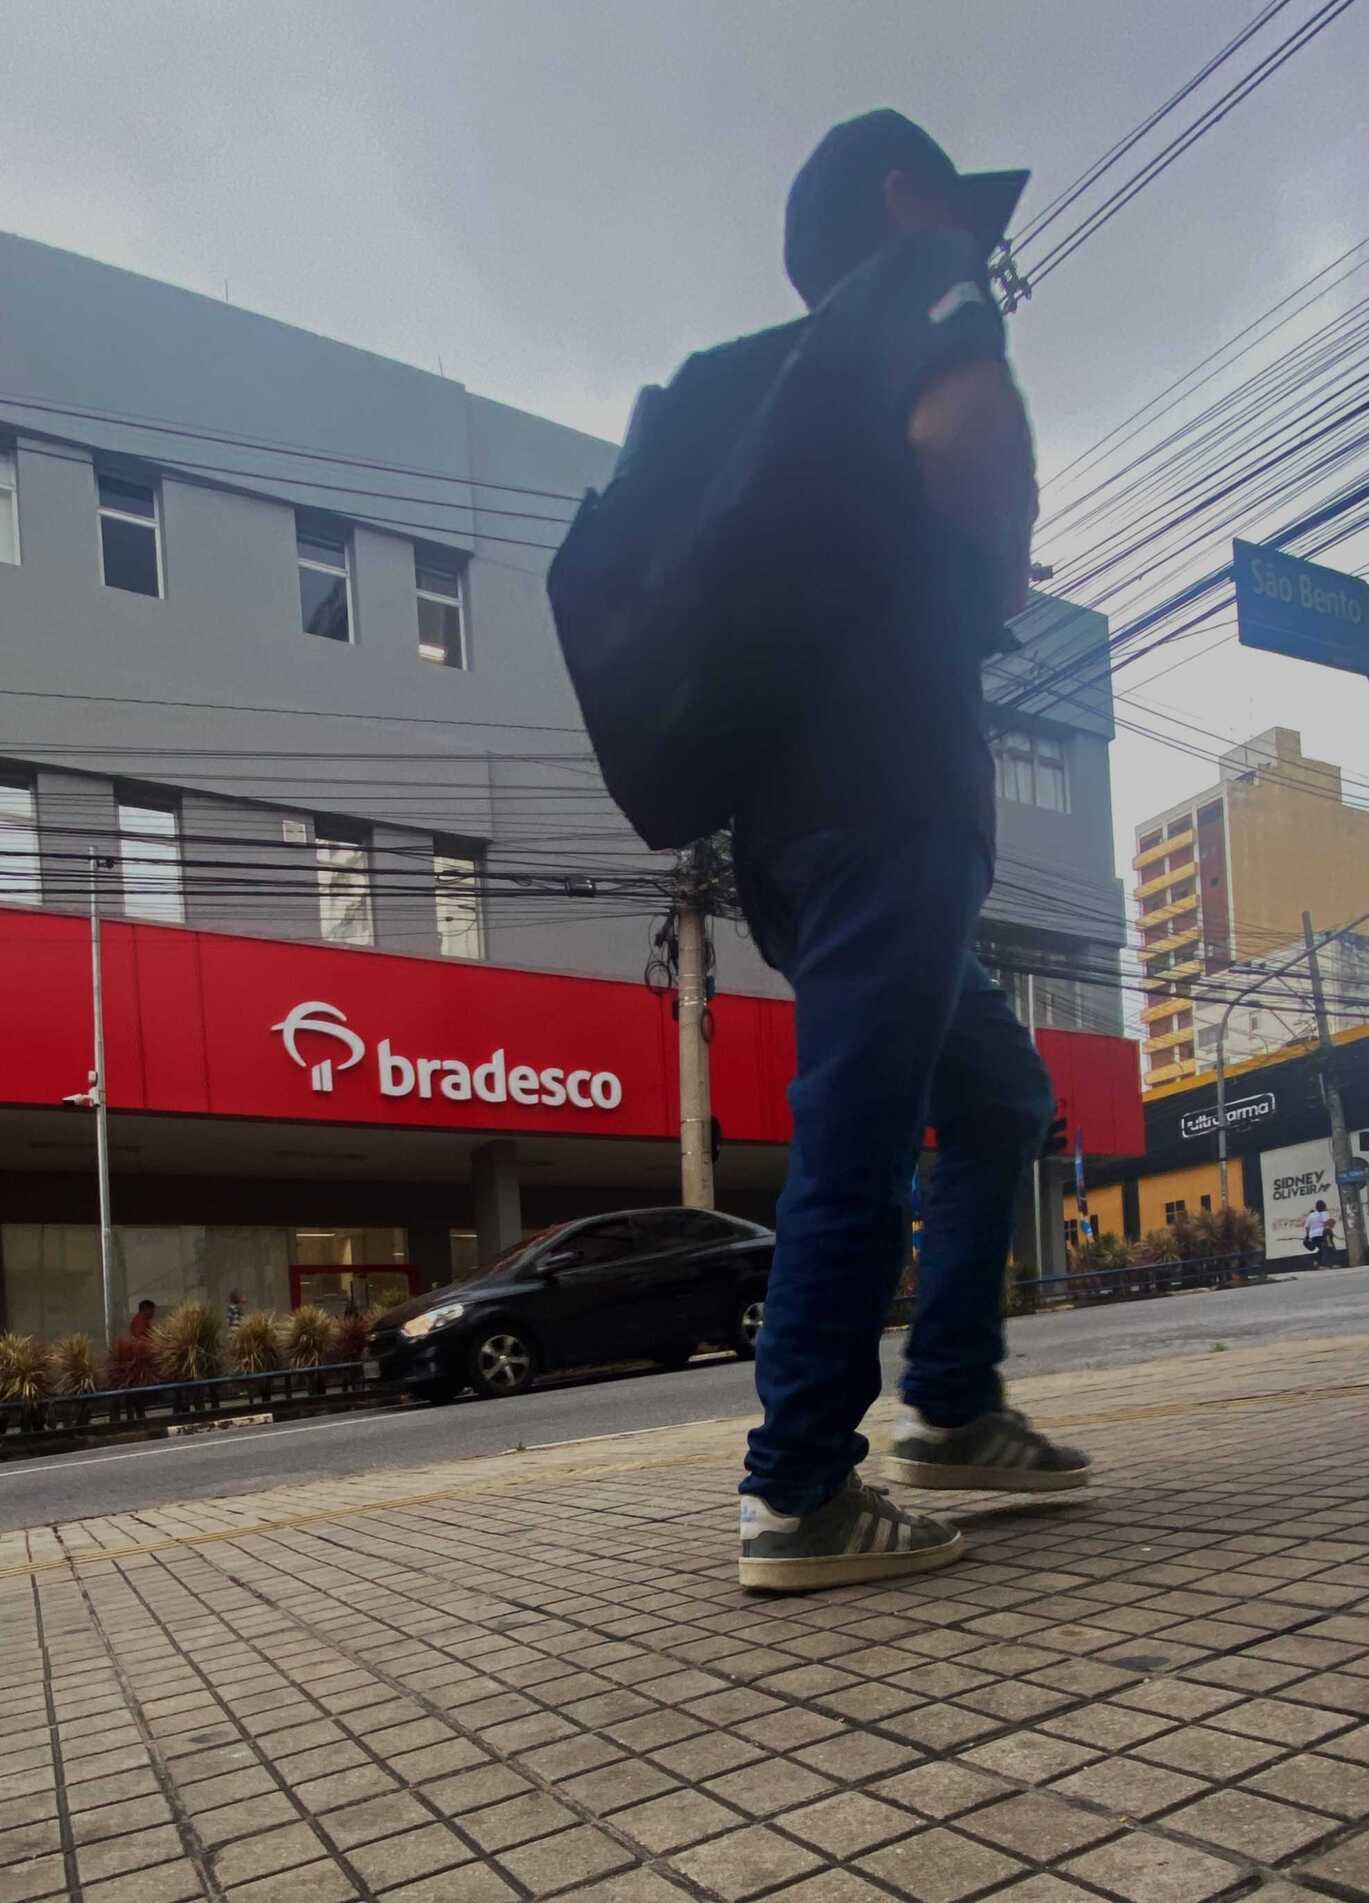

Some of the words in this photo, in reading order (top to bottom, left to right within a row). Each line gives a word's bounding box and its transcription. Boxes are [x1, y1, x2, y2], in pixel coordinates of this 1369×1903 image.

[1250, 558, 1292, 602] São
[1299, 573, 1361, 624] Bento
[377, 1038, 622, 1109] bradesco
[1273, 1170, 1325, 1190] SIDNEY
